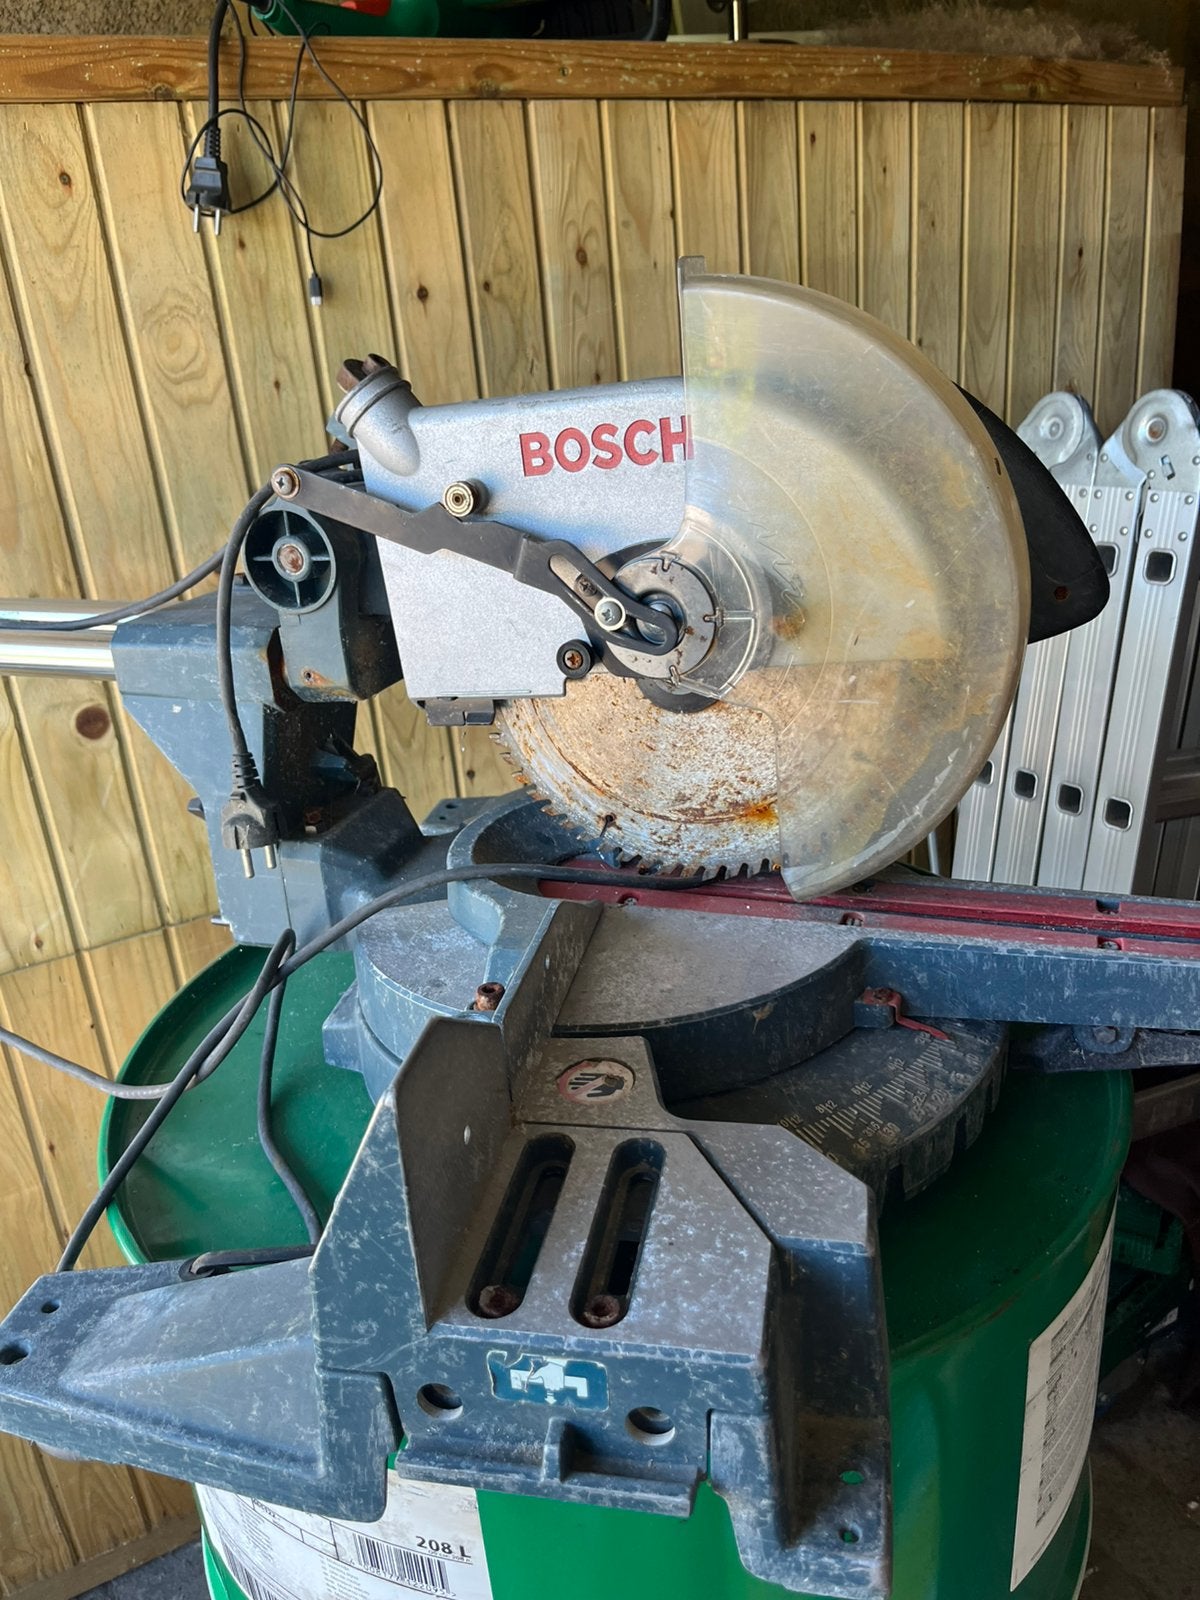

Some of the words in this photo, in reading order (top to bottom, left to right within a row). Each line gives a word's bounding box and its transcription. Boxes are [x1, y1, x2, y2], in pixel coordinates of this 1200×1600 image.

[519, 415, 695, 477] BOSCH
[815, 1099, 838, 1114] 8/12
[415, 1536, 453, 1555] 208
[459, 1545, 472, 1559] L
